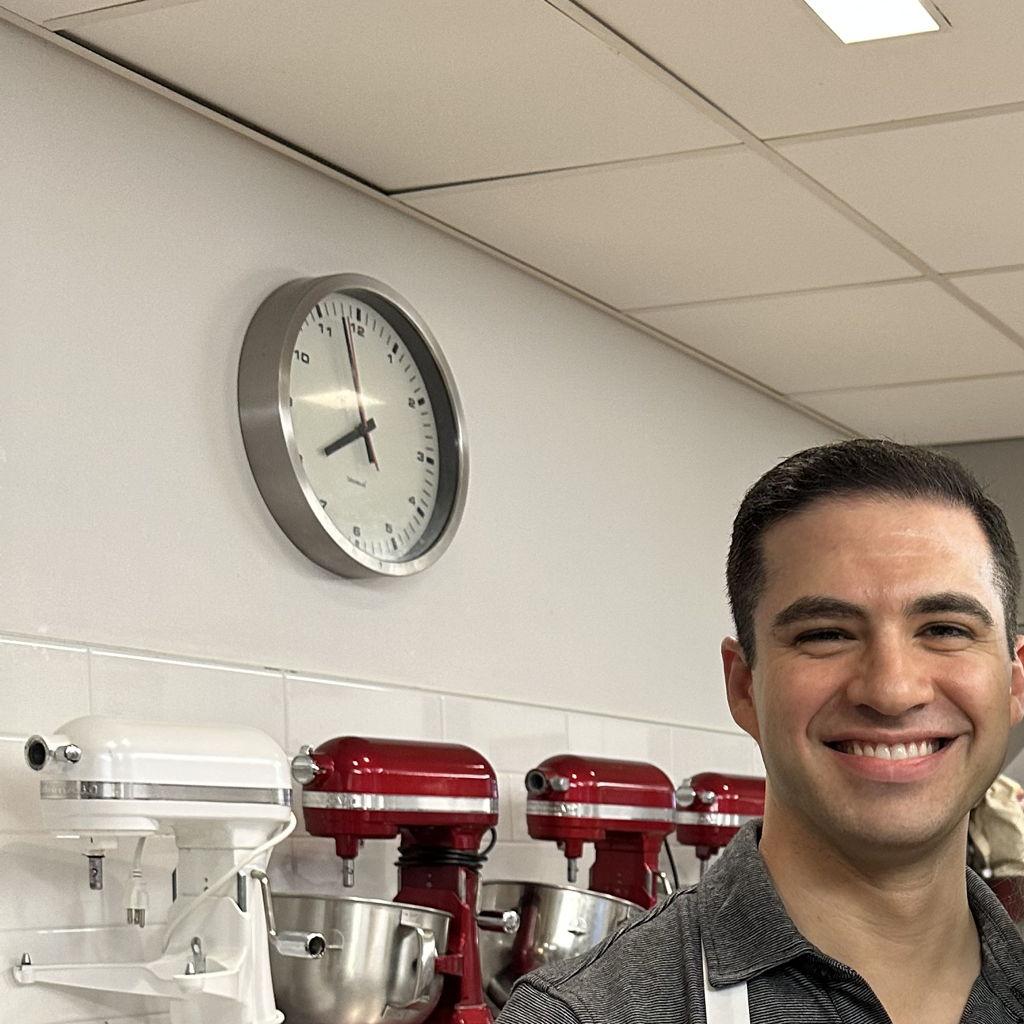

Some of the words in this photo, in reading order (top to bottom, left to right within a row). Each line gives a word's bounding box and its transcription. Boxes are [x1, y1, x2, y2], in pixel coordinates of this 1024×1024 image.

[318, 323, 332, 337] 11
[351, 323, 365, 338] 12
[294, 349, 310, 365] 10
[387, 353, 393, 364] 1
[408, 397, 416, 409] 2
[417, 451, 425, 462] 3
